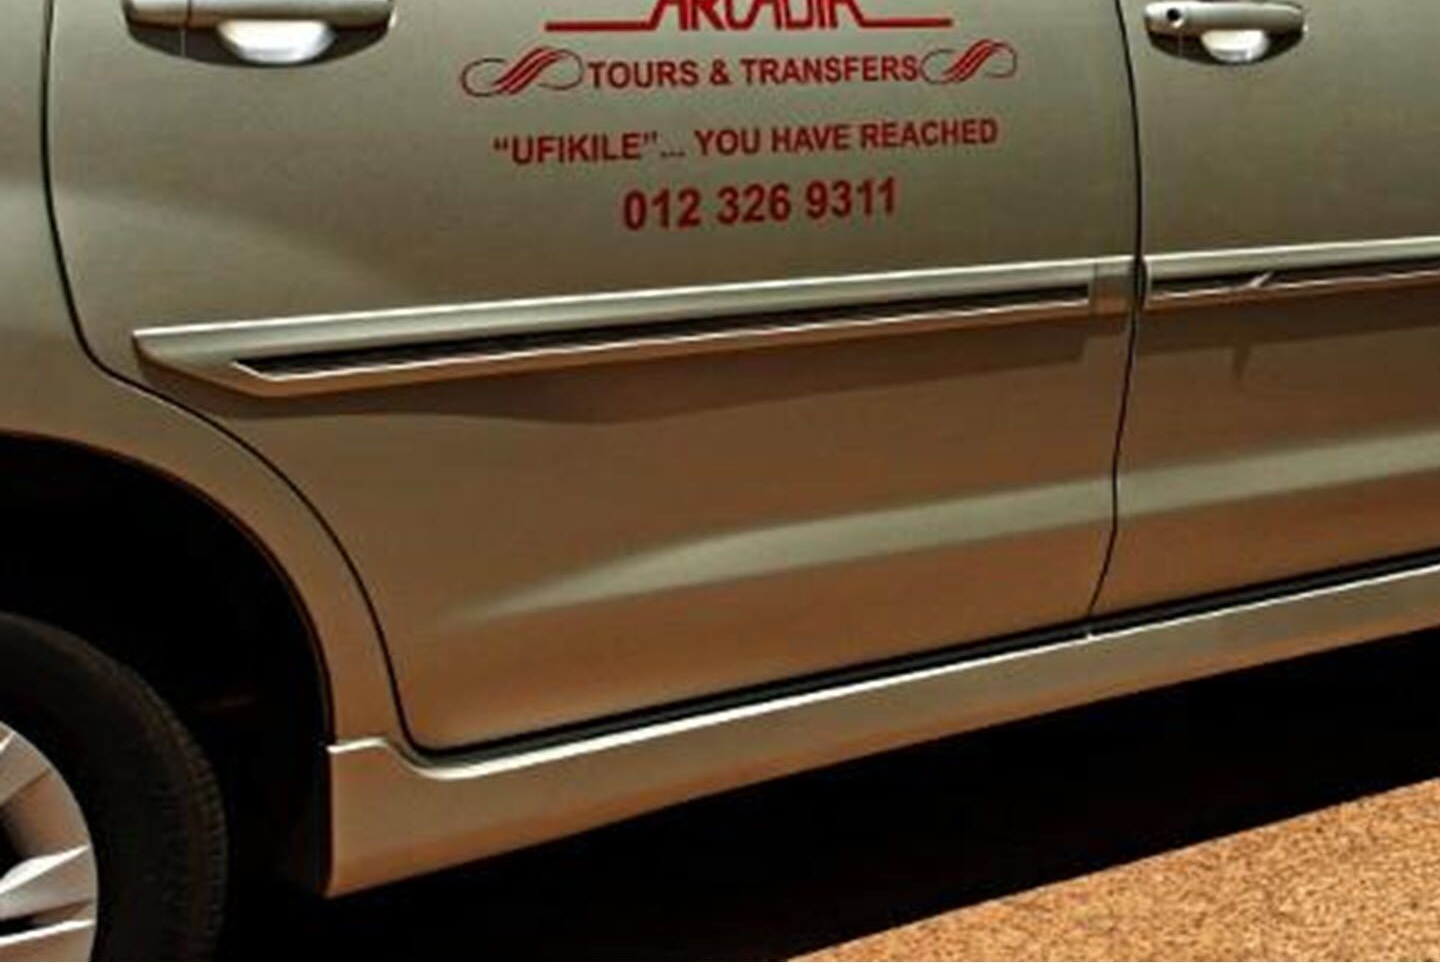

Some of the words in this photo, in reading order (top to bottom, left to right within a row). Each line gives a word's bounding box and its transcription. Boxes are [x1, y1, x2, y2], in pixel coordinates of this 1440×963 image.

[588, 59, 698, 90] TOURS
[708, 57, 731, 86] &
[740, 53, 918, 84] TRANSFERS
[694, 129, 761, 156] YOU
[771, 124, 851, 153] HAVE
[860, 118, 998, 149] REACHED
[622, 189, 701, 231] 012
[715, 183, 791, 225] 326
[805, 177, 896, 219] 9311
